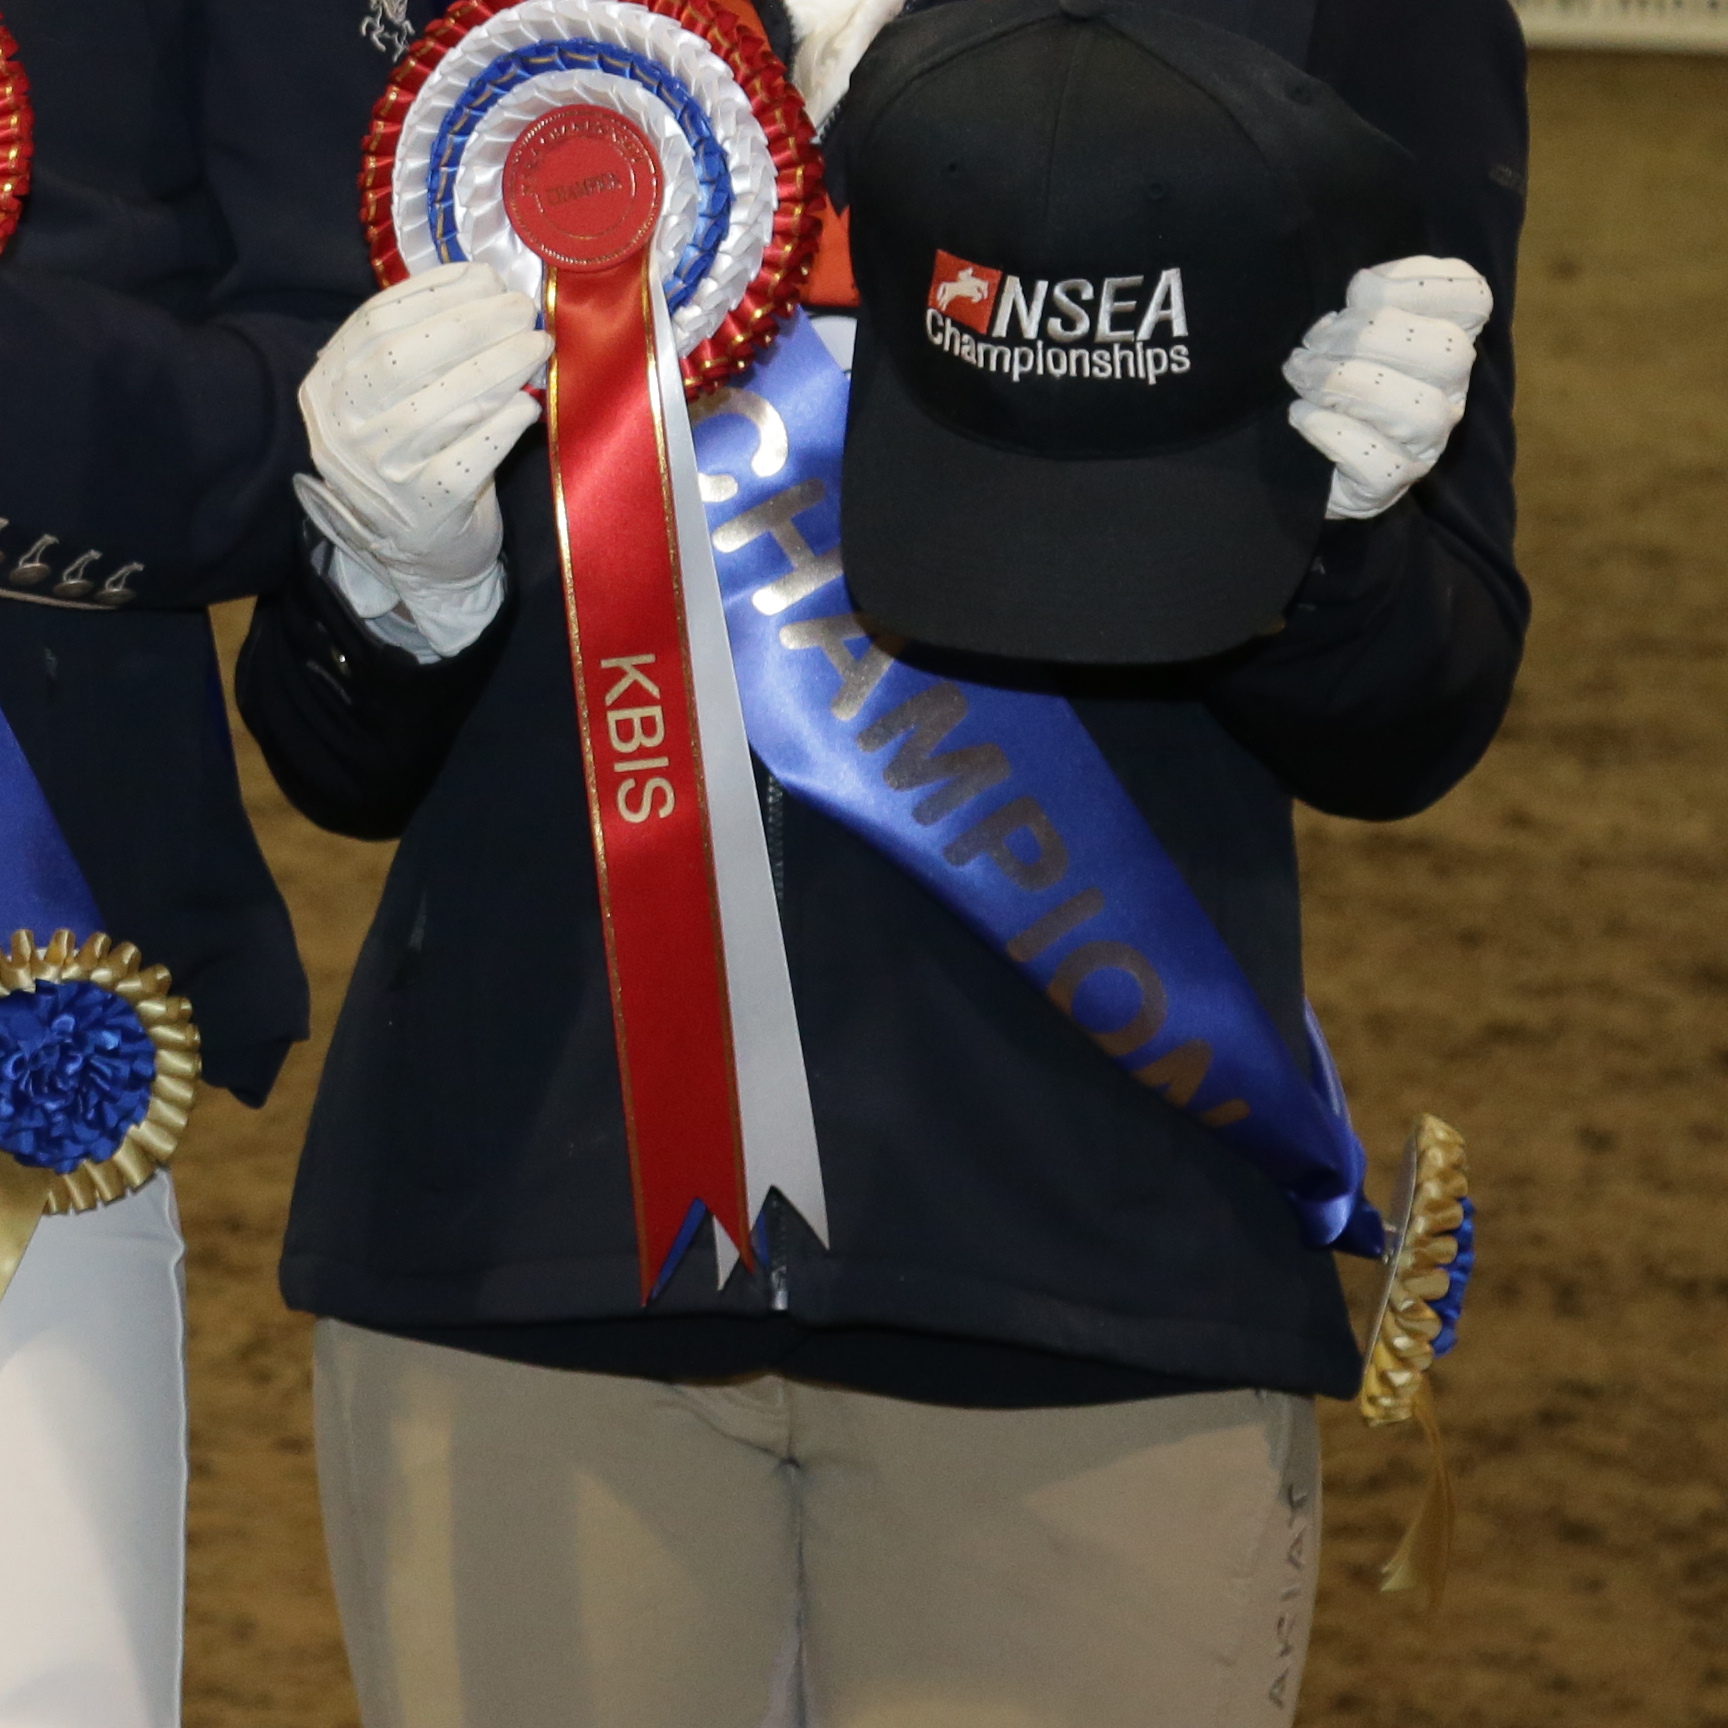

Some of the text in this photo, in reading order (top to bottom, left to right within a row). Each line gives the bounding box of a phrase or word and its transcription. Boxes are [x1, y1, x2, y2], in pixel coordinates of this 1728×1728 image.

[992, 267, 1189, 343] NSEA
[925, 307, 1191, 385] Championships
[599, 653, 676, 824] KBIS
